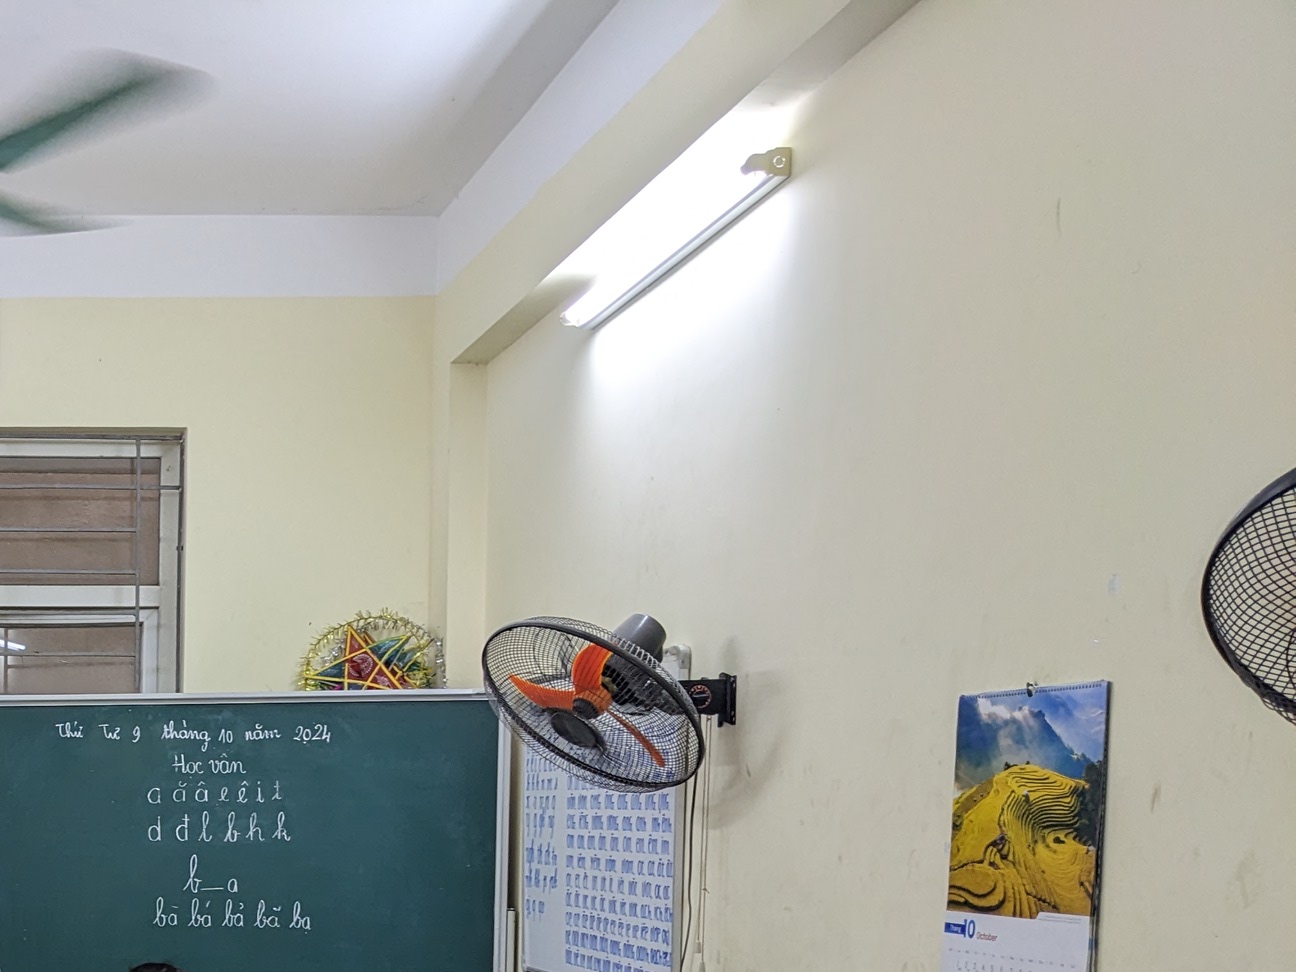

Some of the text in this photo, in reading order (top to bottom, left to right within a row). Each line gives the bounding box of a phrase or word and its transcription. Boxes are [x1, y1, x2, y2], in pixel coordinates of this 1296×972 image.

[132, 726, 140, 742] 9
[218, 729, 233, 743] 10
[245, 724, 281, 740] năm
[293, 723, 330, 744] 2024
[172, 754, 204, 778] Học
[147, 788, 161, 804] a
[173, 781, 187, 802] ă
[195, 781, 208, 802] â
[218, 787, 229, 801] e
[237, 781, 248, 803] ê
[256, 781, 264, 802] i
[148, 816, 161, 841] d
[176, 814, 190, 841] đ
[224, 812, 241, 842] b
[245, 813, 265, 841] h
[964, 919, 976, 938] 10
[976, 932, 998, 941] October
